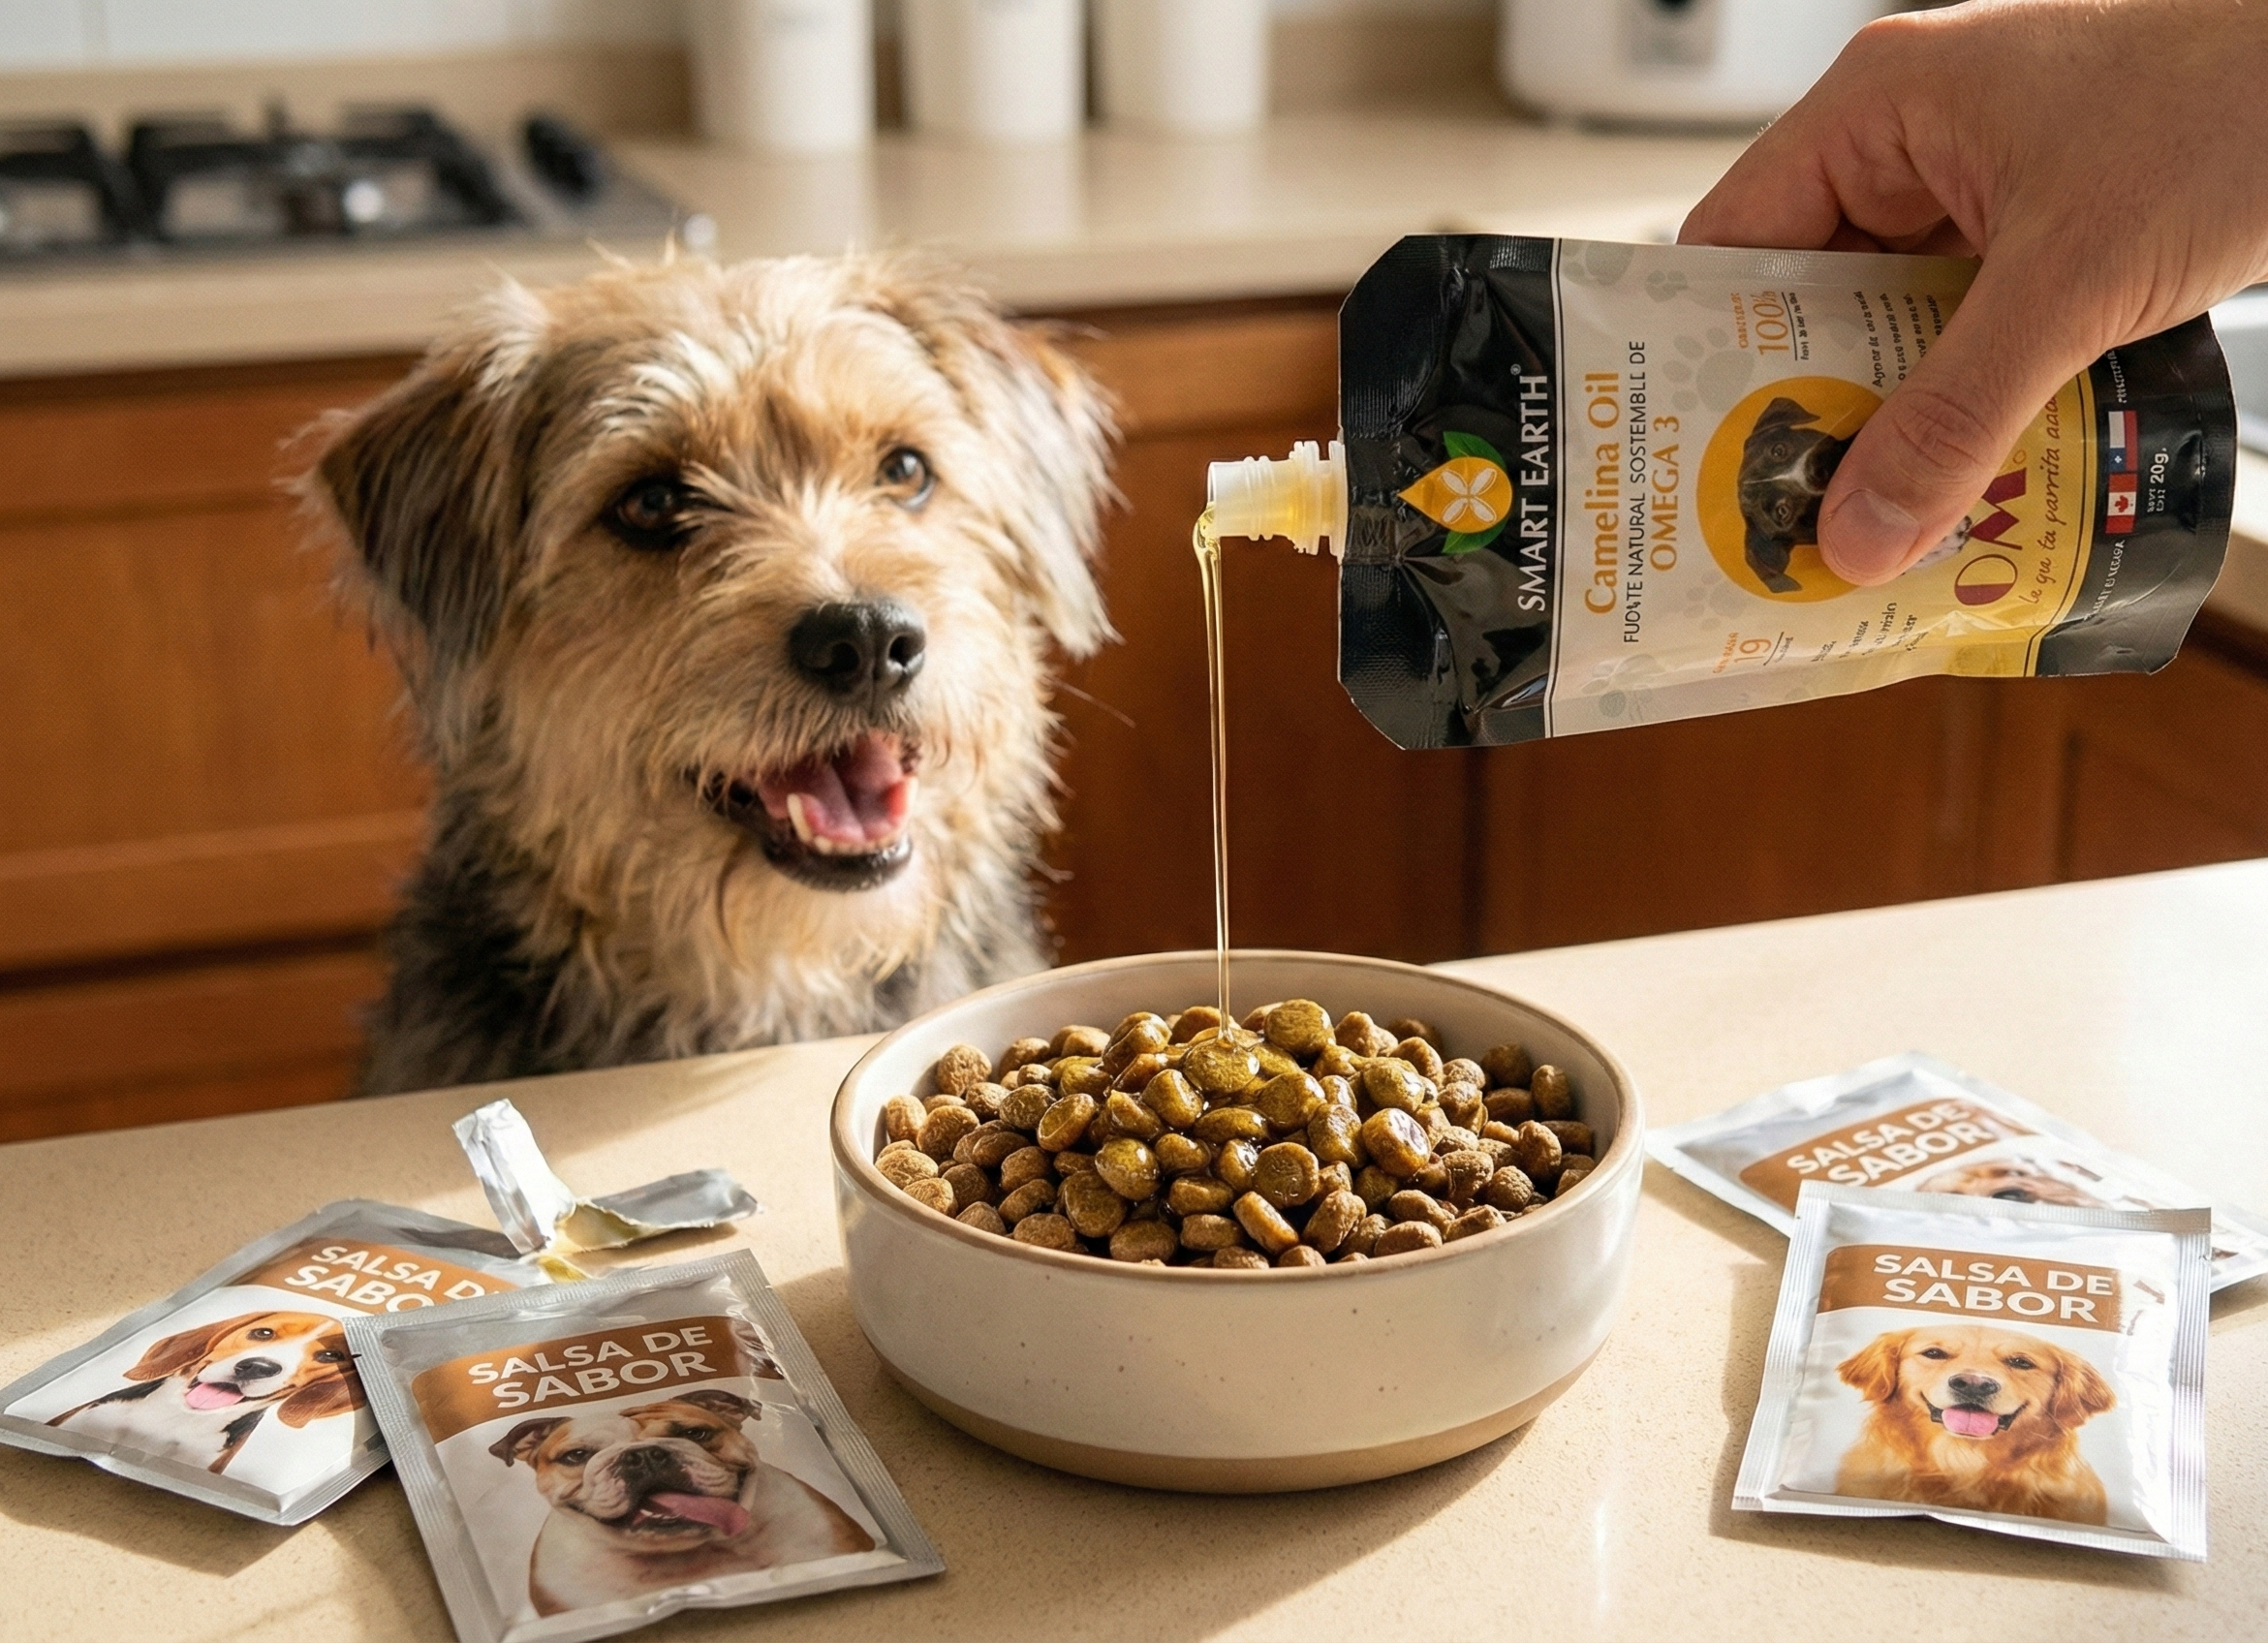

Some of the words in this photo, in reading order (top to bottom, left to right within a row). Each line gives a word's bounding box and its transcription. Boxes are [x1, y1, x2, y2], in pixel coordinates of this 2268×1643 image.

[1629, 341, 1645, 364] DE
[1584, 372, 1619, 429] Oil
[1653, 416, 1679, 433] 3
[1584, 443, 1619, 614] Camelina
[1628, 493, 1645, 575] NATURAL
[1650, 445, 1679, 572] OMEGA
[1517, 498, 1548, 611] SMART
[1786, 1123, 1914, 1174] SALSA
[1906, 1102, 1972, 1132] DE
[1827, 1121, 1995, 1187] SABOR
[284, 1265, 435, 1314] SABO
[311, 1246, 442, 1290] SALSA
[444, 1280, 500, 1300] D
[1874, 1254, 2032, 1287] SALSA
[2047, 1270, 2114, 1296] DE
[1882, 1278, 2099, 1323] SABOR
[468, 1341, 634, 1384] SALSA
[641, 1326, 713, 1352] DE
[492, 1351, 717, 1409] SABOR
